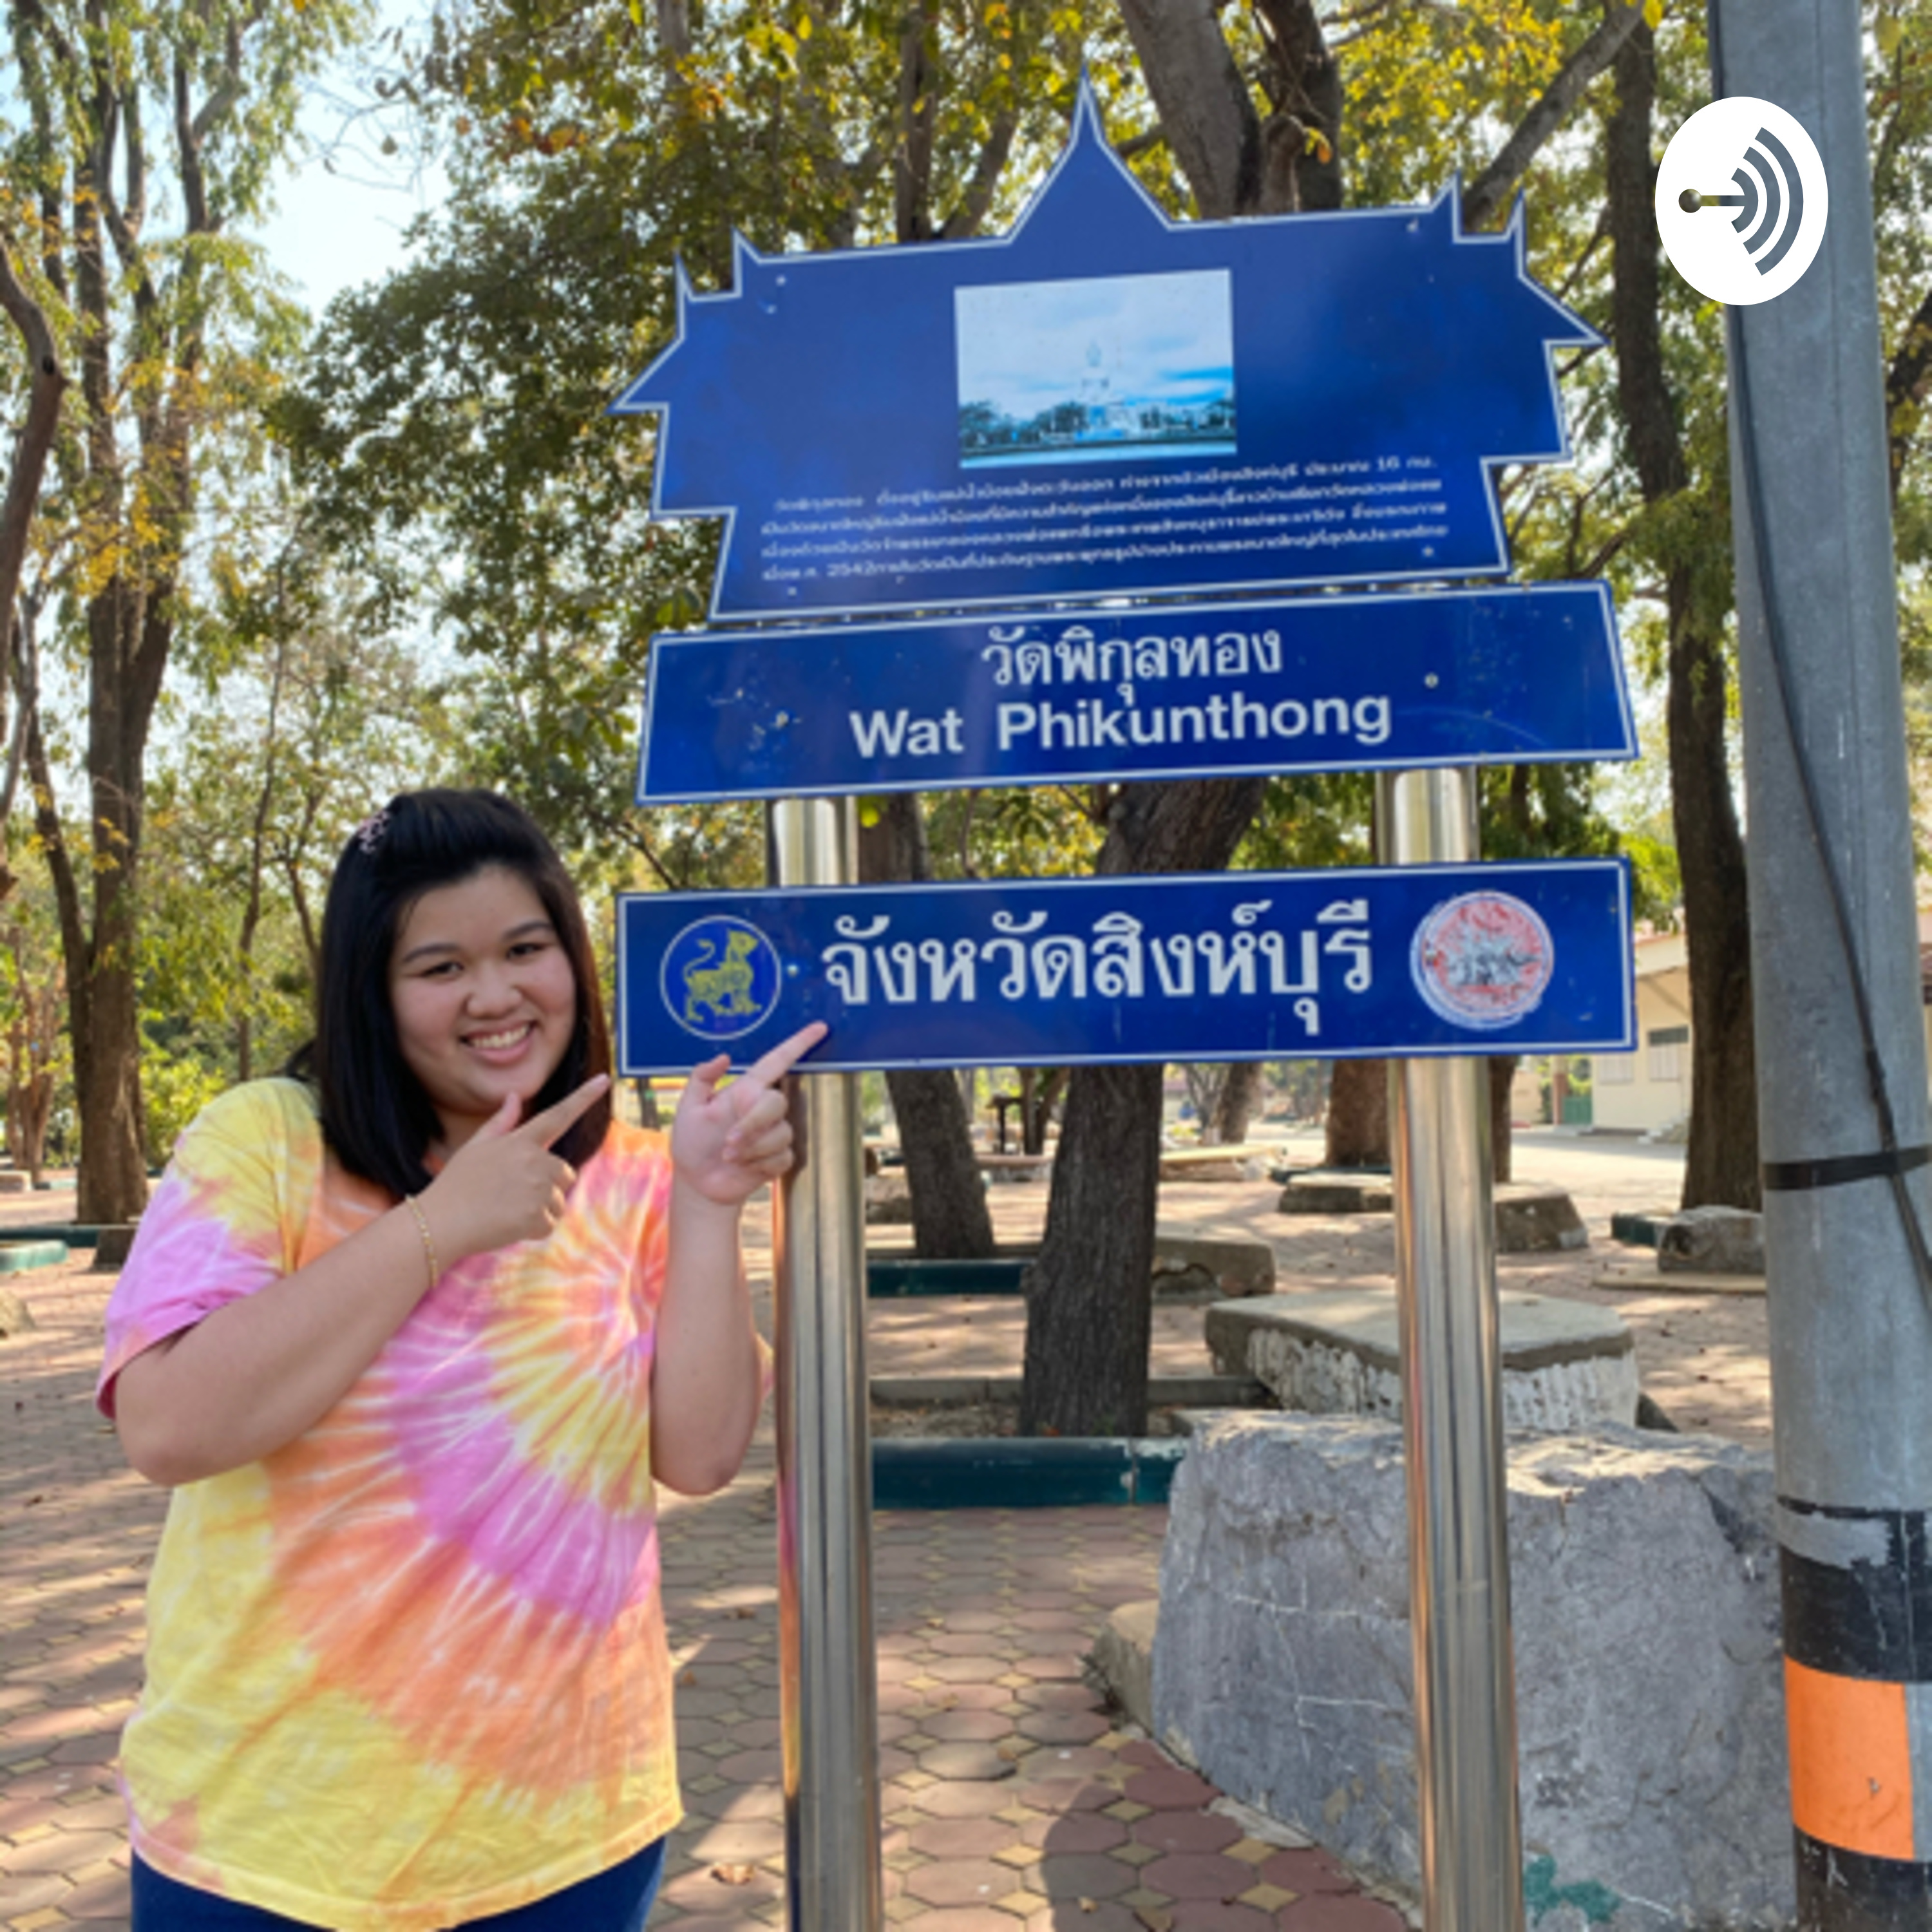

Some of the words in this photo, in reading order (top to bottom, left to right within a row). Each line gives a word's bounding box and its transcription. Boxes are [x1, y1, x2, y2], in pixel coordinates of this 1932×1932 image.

[981, 625, 1281, 706] วัดพิกุลทอง
[849, 708, 964, 757] Wat
[998, 691, 1390, 750] Phikunthong
[821, 899, 1371, 1035] จังหวัดสิงห์บุรี
